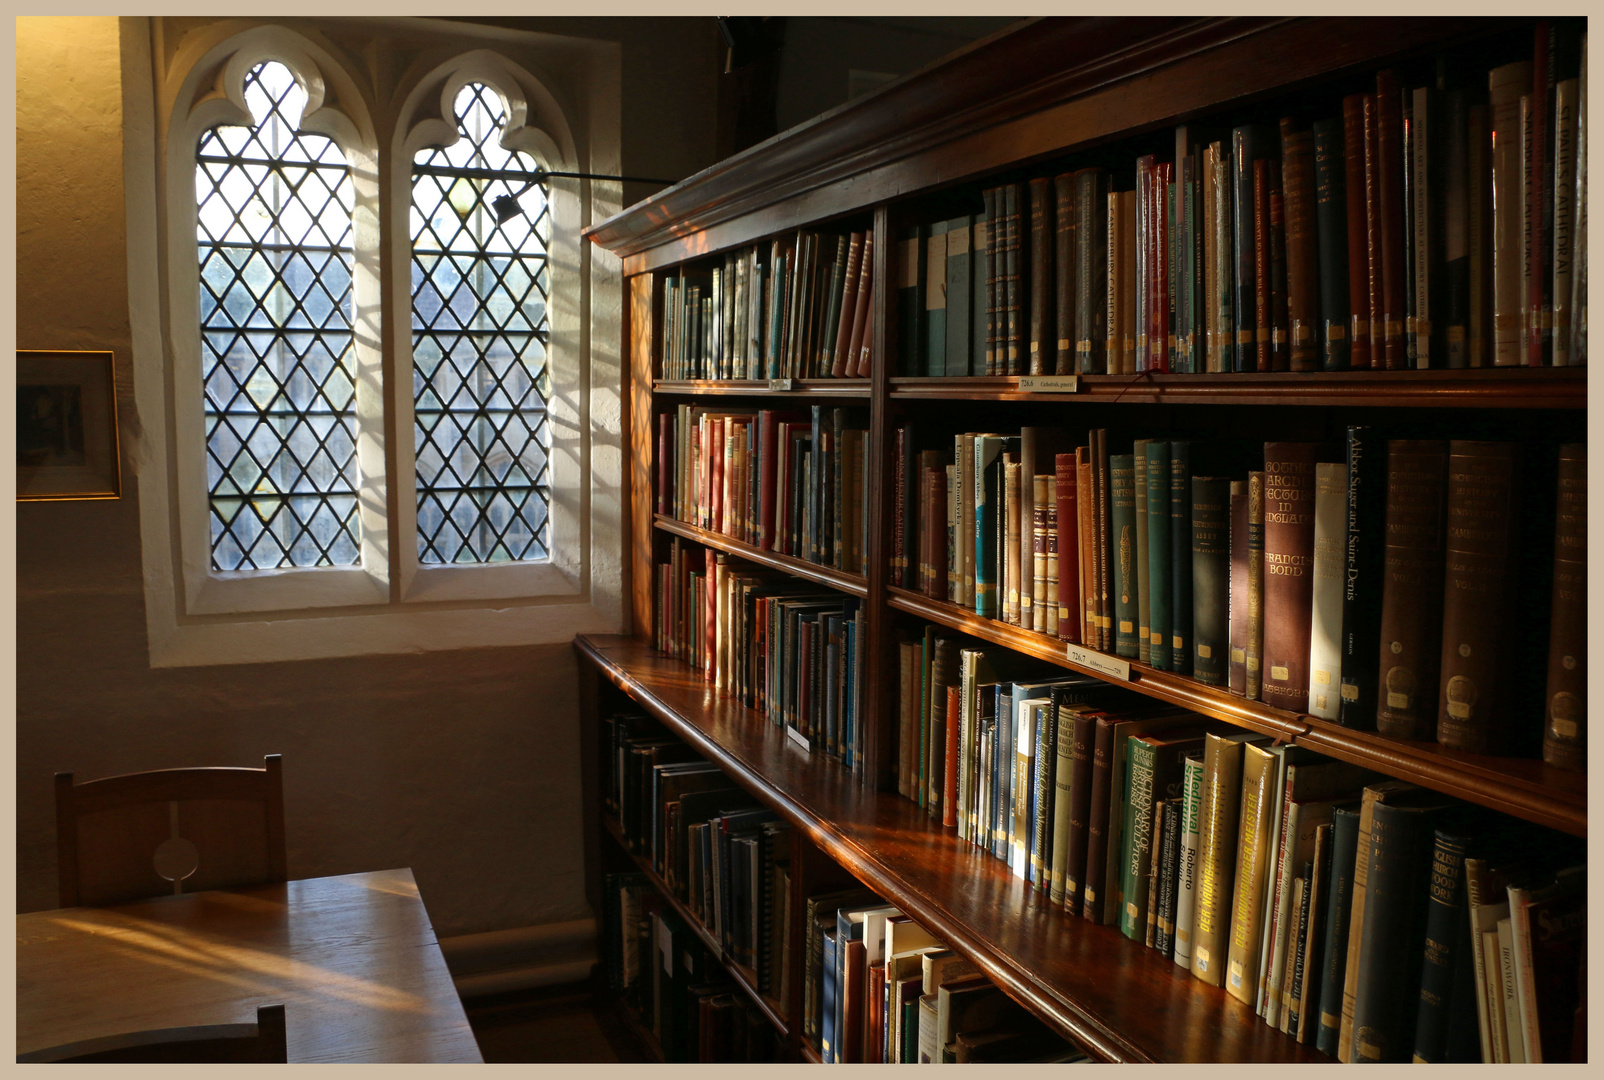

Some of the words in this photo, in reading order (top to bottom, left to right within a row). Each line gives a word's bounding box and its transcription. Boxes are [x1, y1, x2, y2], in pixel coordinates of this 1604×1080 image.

[1561, 105, 1570, 121] ST
[1559, 129, 1570, 179] PAUL'S
[1557, 183, 1569, 275] CATHEDRAL
[1266, 462, 1313, 474] GOTHIC
[1350, 437, 1362, 475] Abbot
[1279, 502, 1293, 512] IN
[1348, 476, 1361, 509] Suger
[1349, 510, 1360, 532] and
[1269, 564, 1303, 577] BOND
[1347, 535, 1360, 601] Saint-Denis
[1072, 651, 1086, 663] 726.7
[1040, 742, 1048, 777] English
[1037, 776, 1048, 812] Church
[1137, 765, 1146, 809] BRITISH
[1141, 768, 1154, 836] DICTIONARY
[1182, 763, 1192, 834] Sculpture
[1189, 766, 1204, 835] Medieval
[1244, 792, 1257, 844] MEISTER
[1281, 809, 1289, 837] STORY
[1131, 810, 1143, 876] SCULPTORS
[1141, 837, 1150, 854] OF
[1280, 840, 1286, 850] OF
[1185, 847, 1196, 891] Roberto
[1202, 834, 1217, 906] NAUMBURGER
[1238, 847, 1253, 921] NAUMBURGER
[1200, 909, 1212, 933] DER
[1300, 877, 1311, 930] NATANSON
[1235, 923, 1247, 948] DER
[1295, 941, 1306, 981] IVORIES
[1502, 946, 1515, 1000] IRONWORK
